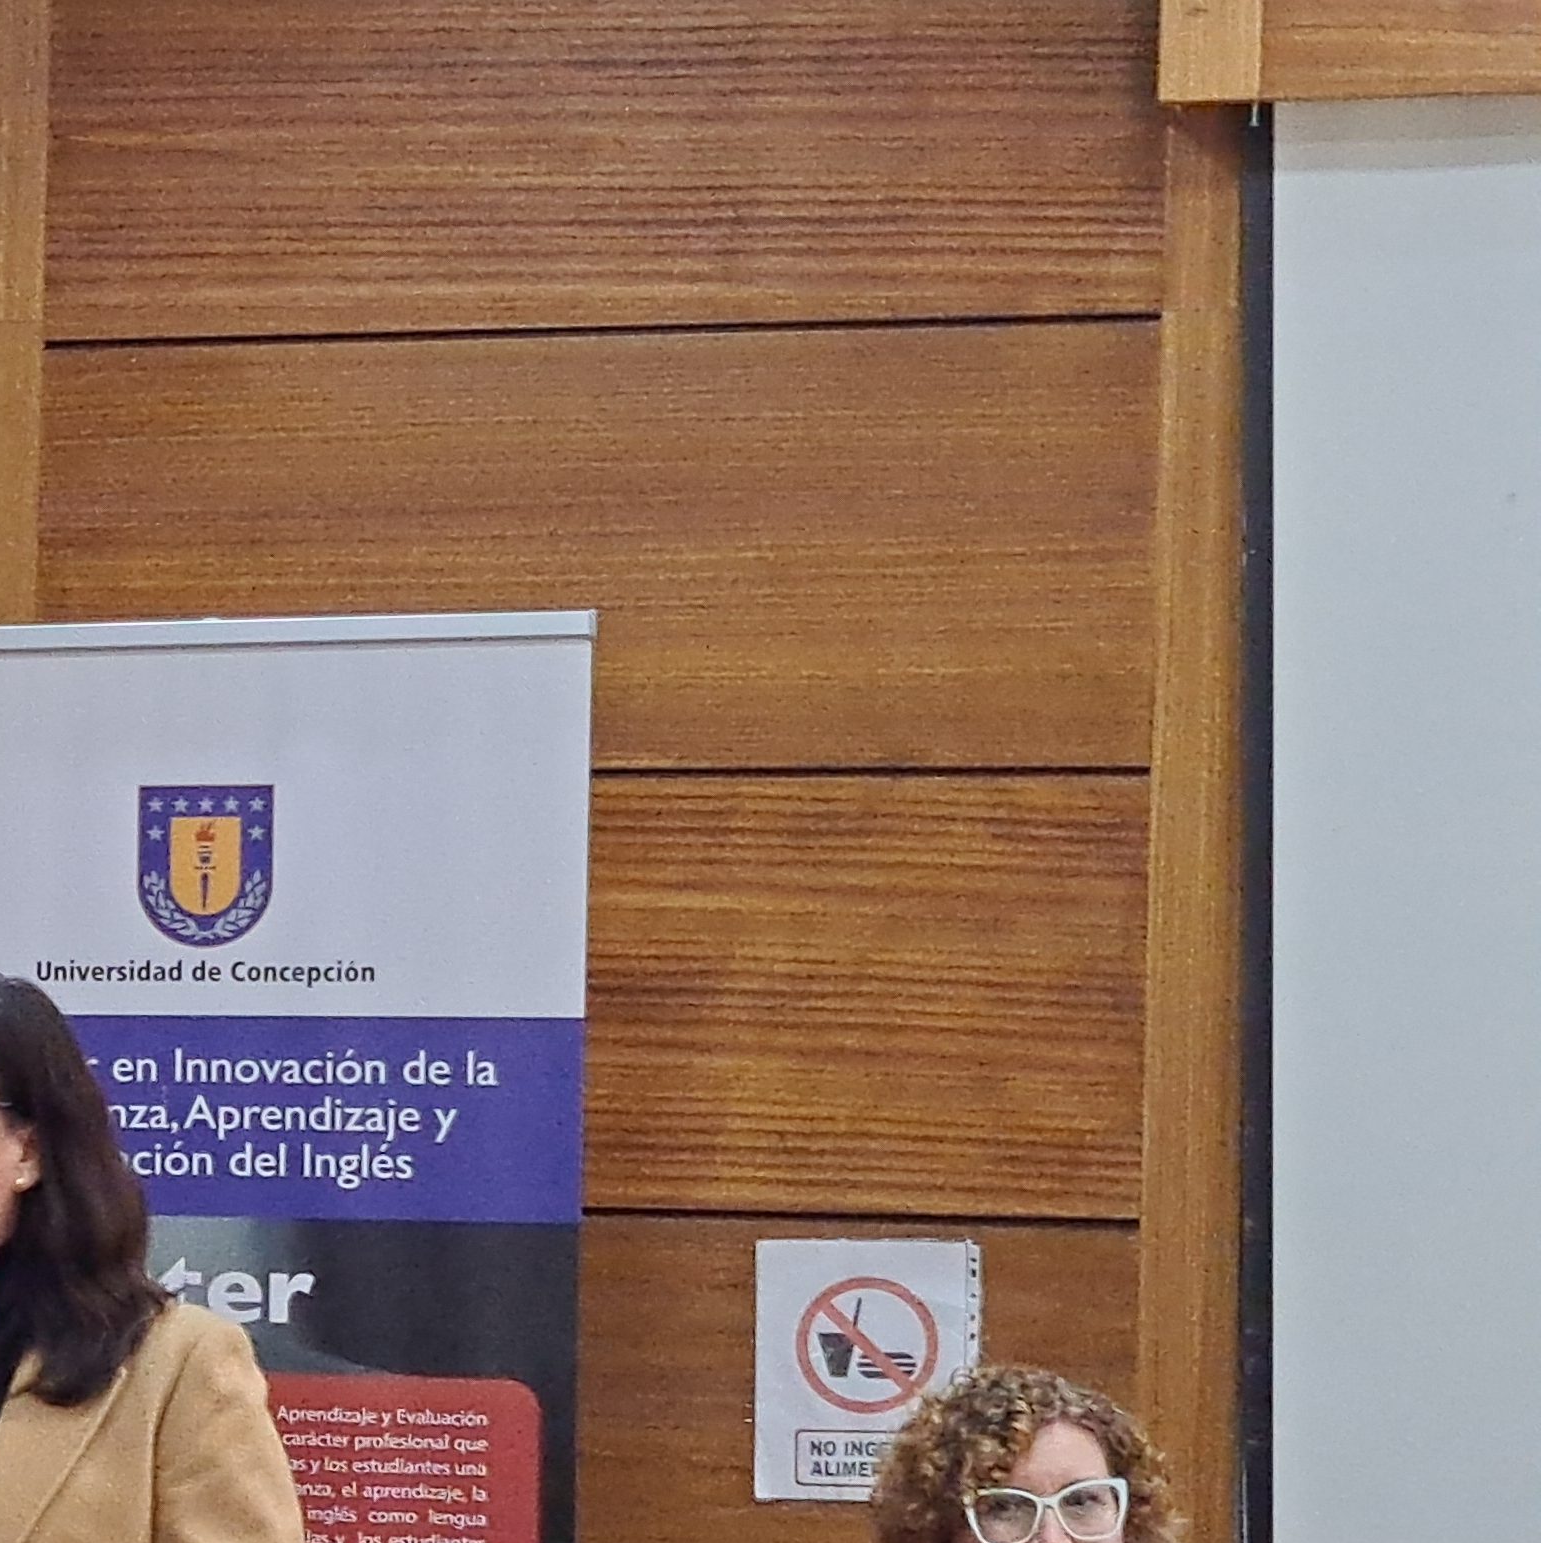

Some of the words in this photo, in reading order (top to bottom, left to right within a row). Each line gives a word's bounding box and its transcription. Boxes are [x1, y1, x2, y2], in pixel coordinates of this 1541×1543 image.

[36, 959, 183, 982] Universidad
[191, 960, 222, 982] de
[231, 960, 376, 988] Concepción
[112, 1057, 159, 1083] en
[173, 1047, 387, 1086] Innovación
[402, 1049, 452, 1086] de
[467, 1049, 499, 1087] la
[183, 1094, 422, 1142] Aprendizaje
[433, 1106, 459, 1144] y
[228, 1141, 287, 1178] del
[302, 1141, 415, 1190] Inglés
[277, 1406, 377, 1427] Aprendizaje
[381, 1410, 393, 1428] y
[396, 1408, 489, 1427] Evaluación
[282, 1432, 350, 1448] carácter
[354, 1433, 449, 1452] profesional
[454, 1438, 490, 1454] que
[809, 1441, 836, 1457] NO
[309, 1458, 322, 1476] y
[323, 1456, 349, 1473] los
[352, 1458, 451, 1476] estudiantes
[341, 1481, 358, 1498] el
[472, 1486, 488, 1502] la
[306, 1506, 358, 1525] inglés
[367, 1510, 418, 1524] como
[429, 1509, 487, 1529] lengua
